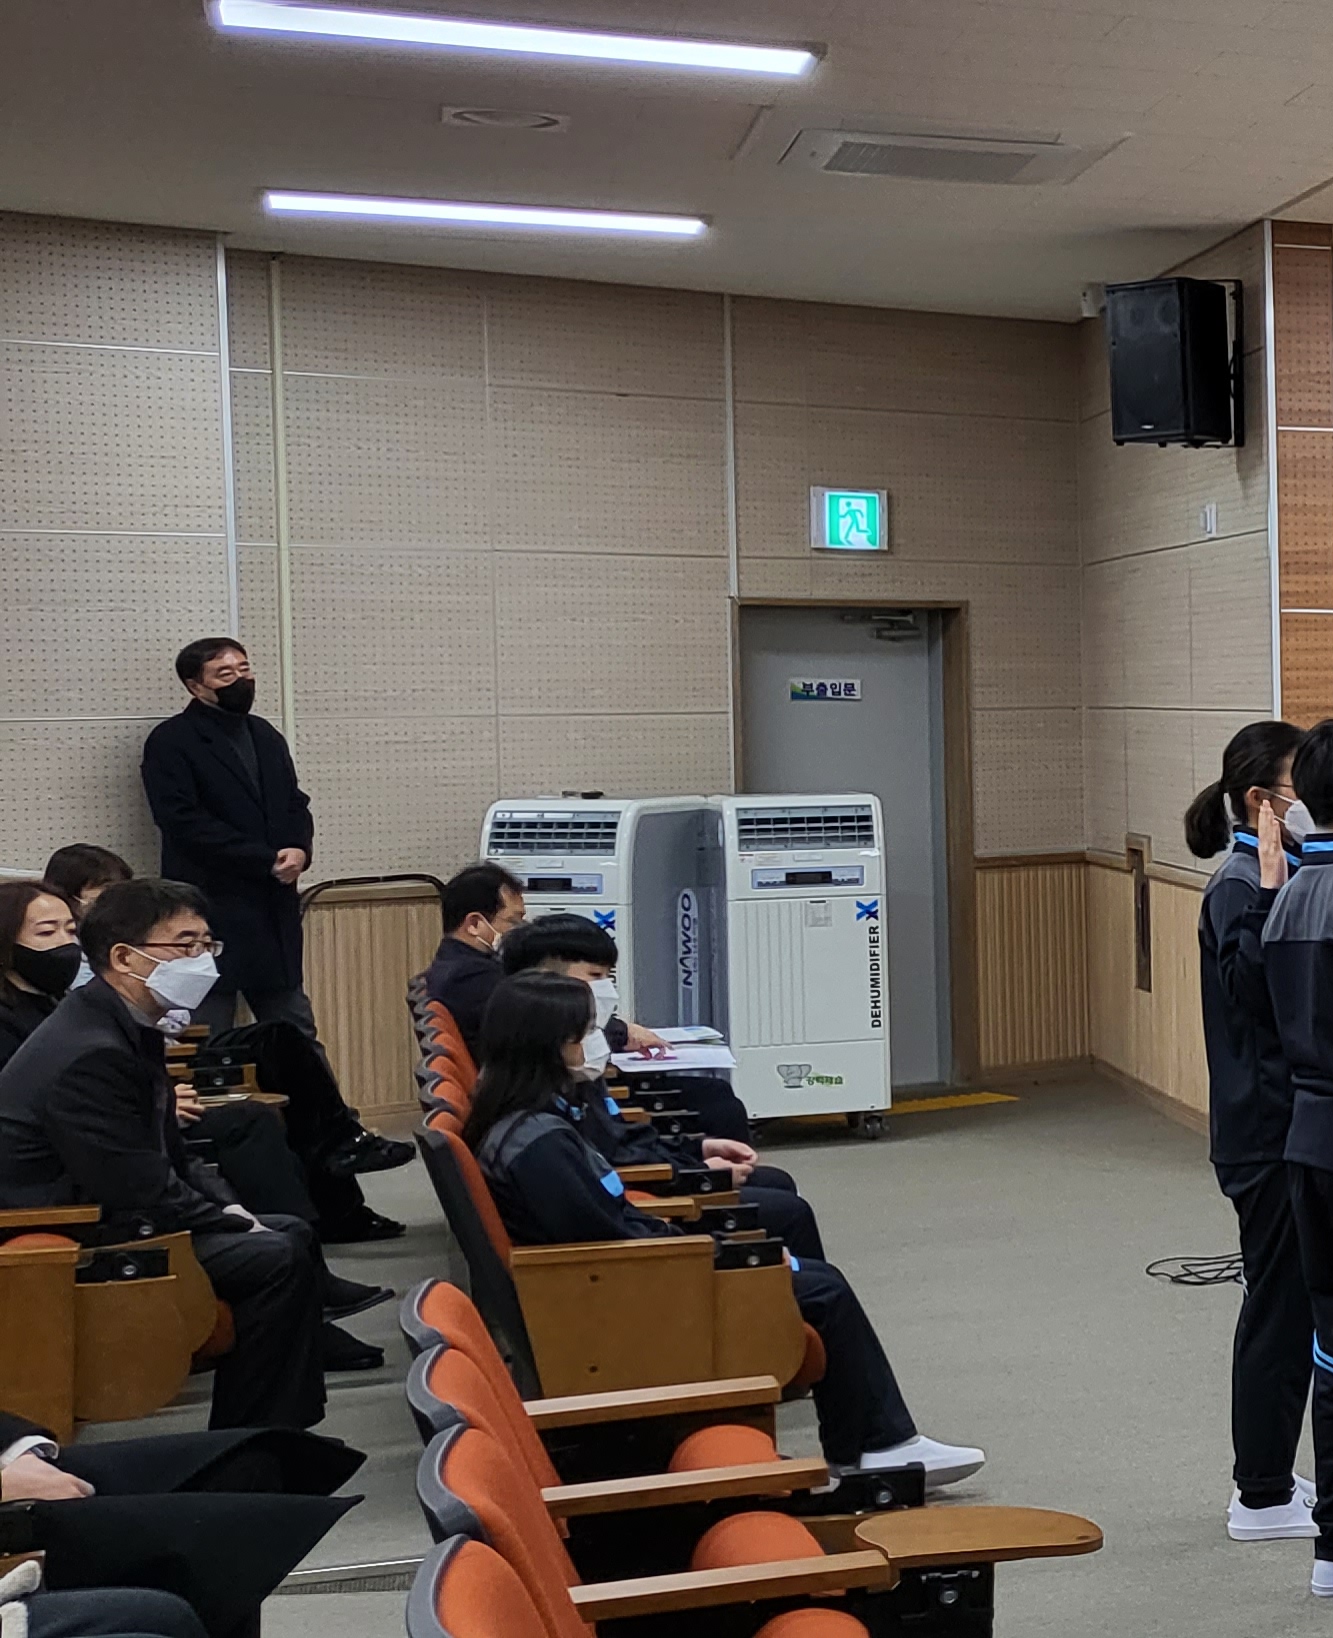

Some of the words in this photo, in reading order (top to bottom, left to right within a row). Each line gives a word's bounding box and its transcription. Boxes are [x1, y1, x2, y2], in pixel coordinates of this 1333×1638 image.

[801, 681, 857, 697] 부출입문
[680, 893, 692, 986] NAWOO
[868, 925, 882, 1028] DEHUMIDIFIER
